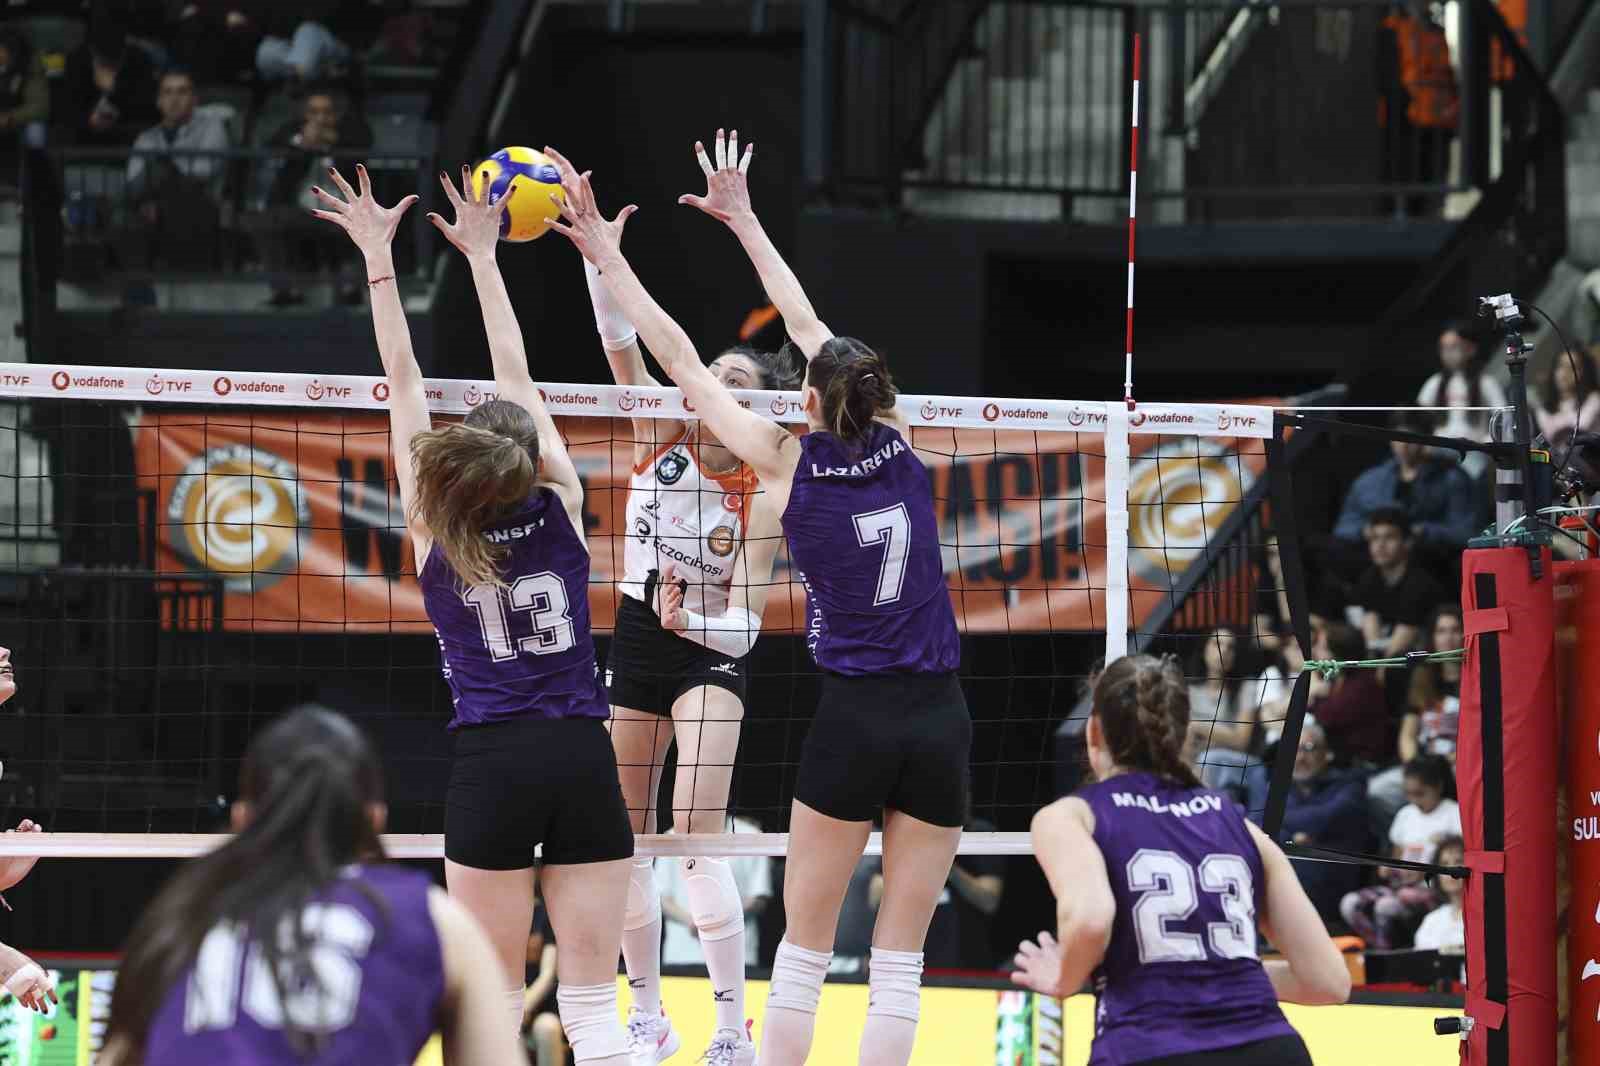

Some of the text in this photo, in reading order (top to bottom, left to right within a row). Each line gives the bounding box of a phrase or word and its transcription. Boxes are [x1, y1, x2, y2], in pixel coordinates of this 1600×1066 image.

[3, 375, 31, 386] TVF
[73, 376, 125, 388] vodafone
[167, 381, 192, 393] TVF
[234, 382, 285, 393] vodafone
[326, 387, 351, 398] TVF
[483, 392, 500, 401] TV
[549, 394, 598, 405] vodafone
[638, 398, 662, 408] TVF
[790, 402, 804, 412] TV
[939, 407, 963, 418] TVF
[1001, 408, 1048, 420] vodafone
[1148, 412, 1194, 423] vodafone
[1232, 417, 1256, 427] TVF
[811, 439, 905, 478] LAZAREVA
[851, 502, 912, 607] 7
[464, 570, 577, 663] 13
[1111, 792, 1222, 818] MALNOV
[1125, 848, 1262, 964] 23
[183, 902, 376, 1036] 16
